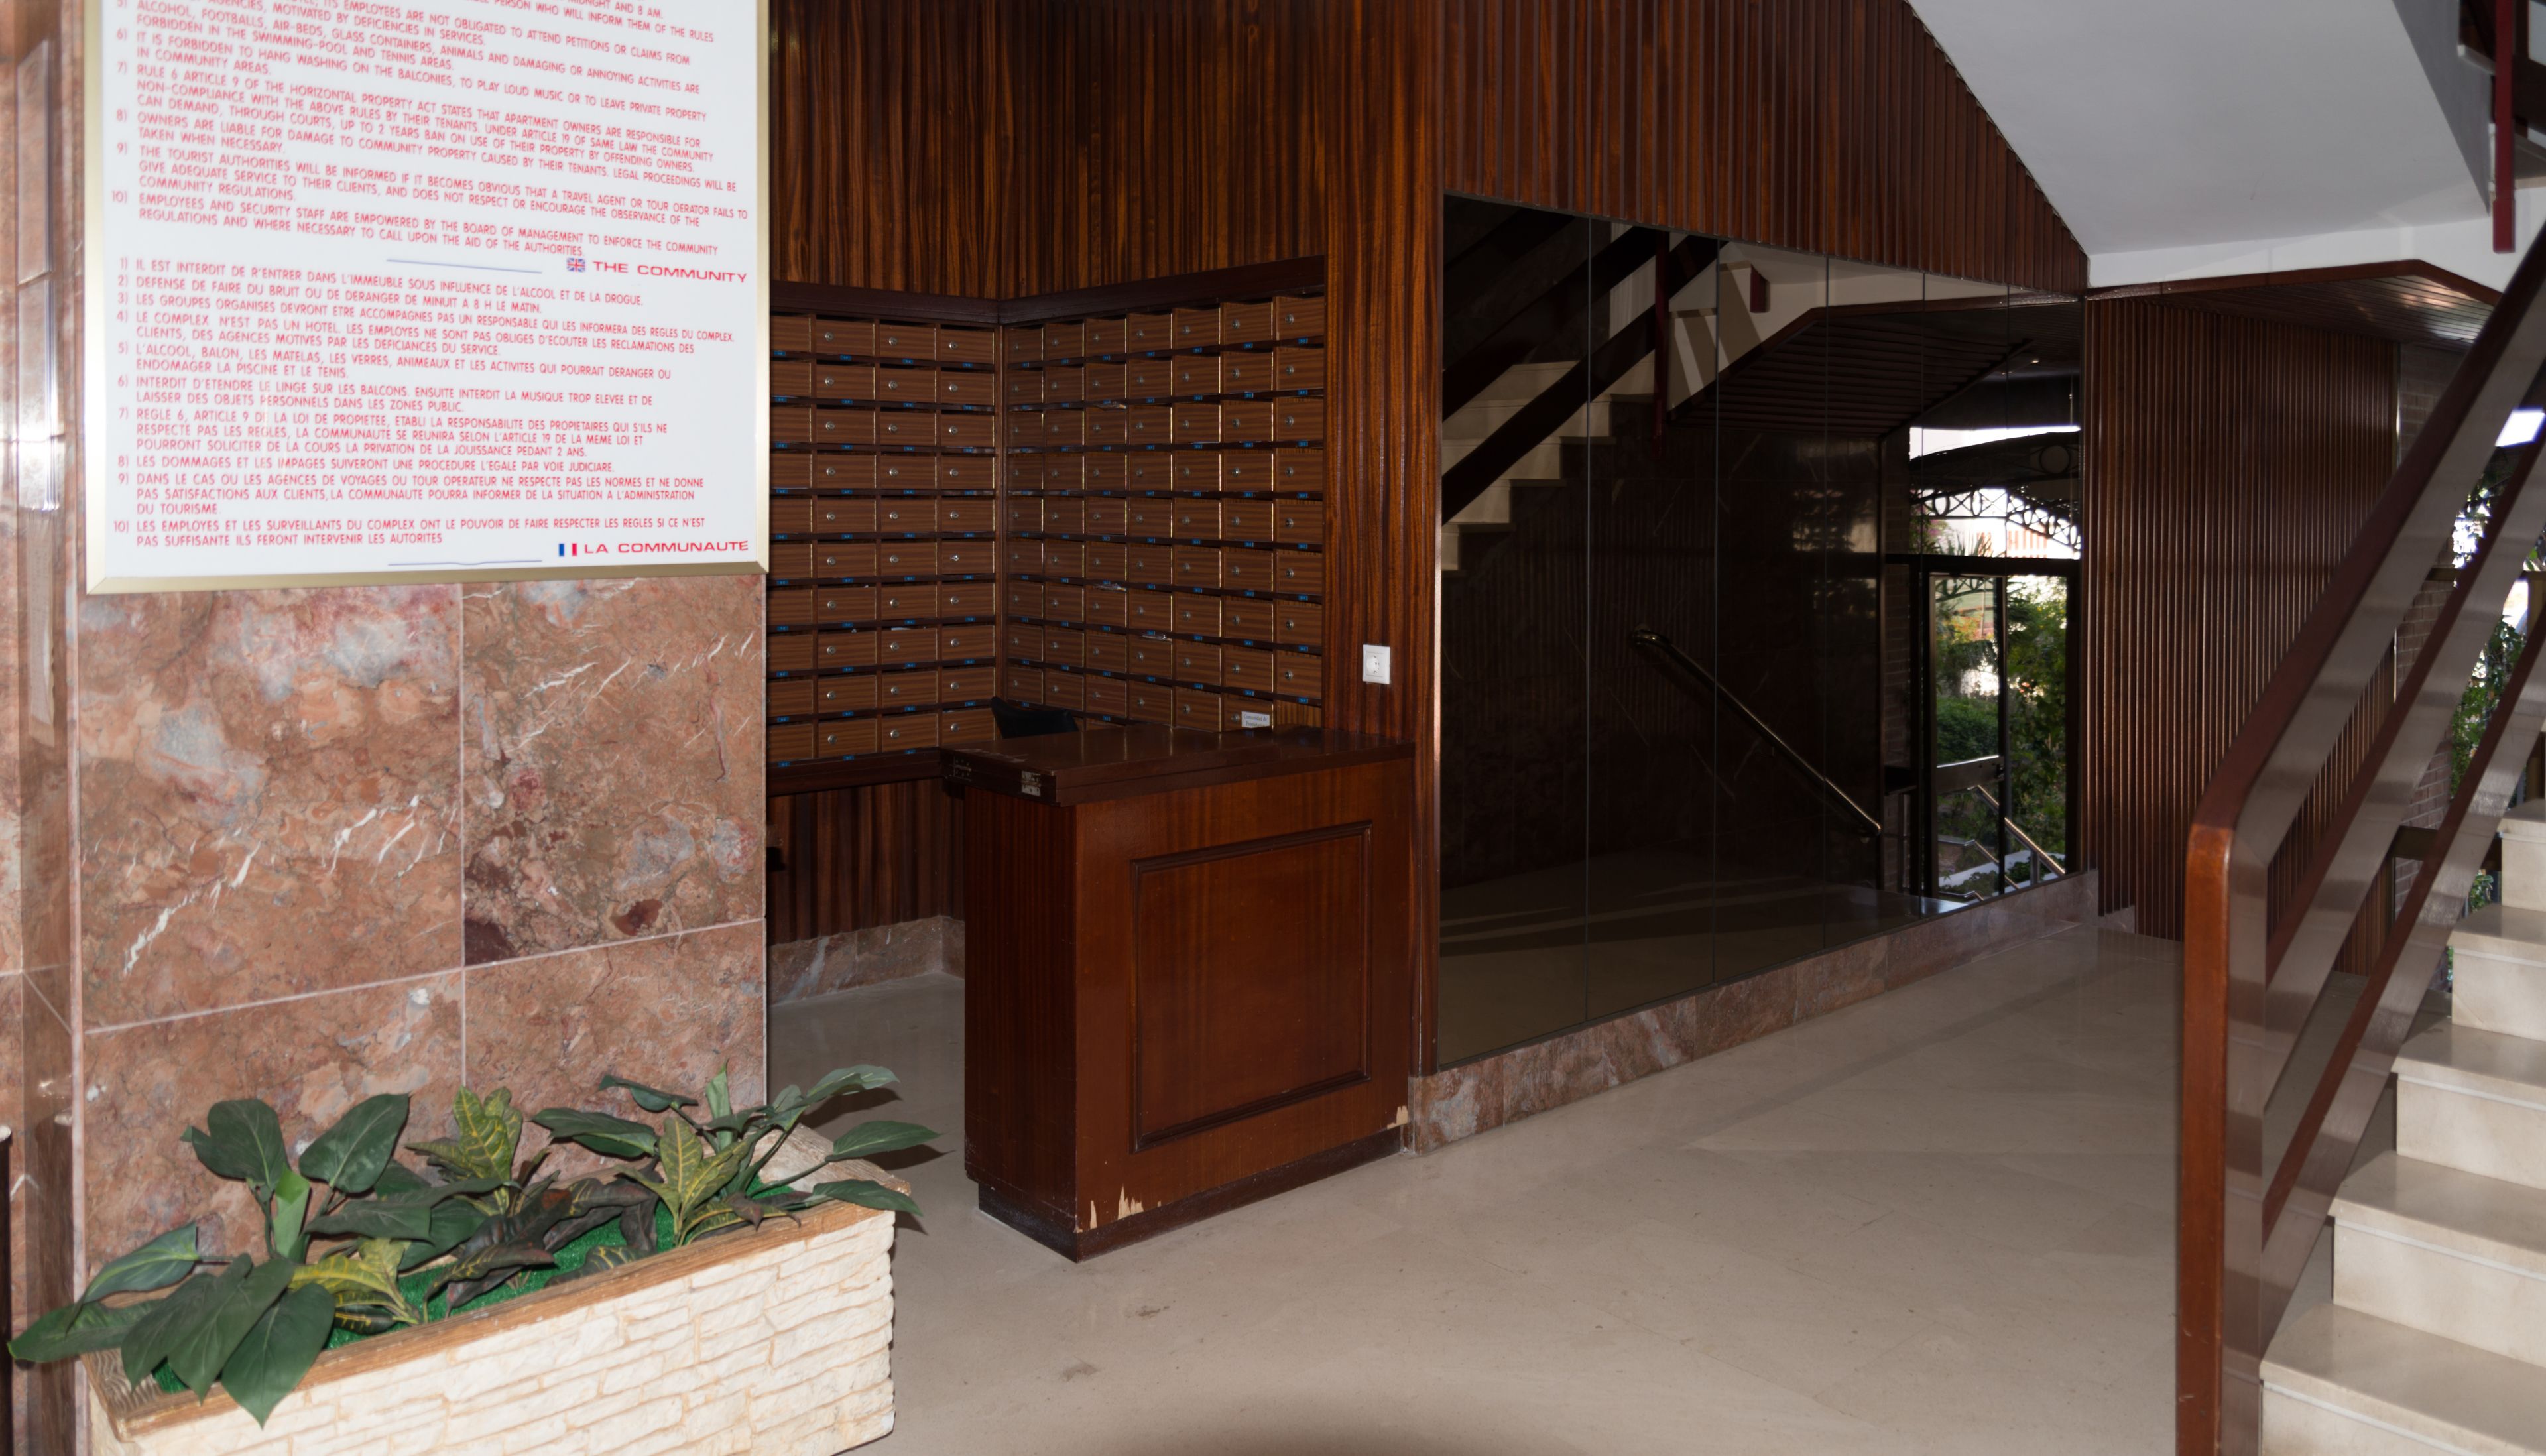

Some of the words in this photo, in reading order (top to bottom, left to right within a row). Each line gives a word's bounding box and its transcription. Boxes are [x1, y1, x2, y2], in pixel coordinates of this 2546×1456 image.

[137, 13, 202, 32] FORBIDDEN
[208, 24, 221, 34] IN
[226, 27, 247, 38] THE
[252, 30, 346, 53] SWIMMING-POOL
[352, 44, 376, 58] AND
[381, 49, 416, 64] TENNIS
[420, 55, 453, 69] AREAS.
[137, 46, 149, 56] IN
[155, 49, 228, 67] COMMUNITY
[233, 59, 271, 74] AREAS.
[137, 94, 162, 107] CAN
[169, 98, 223, 115] DEMAND,
[229, 105, 285, 122] THROUGH
[290, 112, 335, 129] COURTS,
[340, 118, 355, 131] UP
[360, 120, 374, 133] TO
[379, 123, 385, 134] 2
[389, 124, 420, 138] YEARS
[424, 129, 446, 141] BAN
[450, 132, 466, 144] ON
[469, 135, 488, 147] USE
[493, 137, 505, 149] OF
[509, 139, 536, 152] THEIR
[540, 143, 584, 158] PROPERTY
[588, 150, 599, 160] BY
[603, 151, 652, 166] OFFENDING
[657, 158, 696, 172] OWNERS.
[139, 126, 174, 141] TAKEN
[180, 131, 215, 145] WHEN
[220, 136, 285, 152] NECESSARY.
[138, 175, 213, 192] COMMUNITY
[218, 182, 296, 200] REGULATIONS.
[139, 160, 165, 174] GIVE
[171, 162, 227, 180] ADEQUATE
[234, 169, 277, 184] SERVICE
[282, 174, 298, 186] TO
[303, 176, 332, 189] THEIR
[337, 179, 381, 195] CLIENTS,
[385, 184, 408, 196] AND
[412, 188, 440, 201] DOES
[444, 191, 464, 202] NOT
[468, 193, 509, 206] RESPECT
[513, 198, 526, 208] OR
[530, 199, 586, 215] ENCOURAGE
[589, 206, 606, 216] THE
[610, 208, 666, 223] OBSERVANCE
[670, 213, 681, 224] OF
[684, 215, 699, 226] THE
[139, 208, 218, 224] REGULATIONS
[223, 215, 247, 226] AND
[253, 217, 291, 230] WHERE
[296, 221, 356, 236] NECESSARY
[361, 226, 375, 239] TO
[379, 229, 402, 240] CALL
[408, 231, 438, 243] UPON
[443, 233, 460, 245] THE
[464, 235, 482, 246] AID
[485, 237, 499, 249] OF
[503, 239, 520, 249] THE
[524, 241, 585, 256] AUTHORITIES.
[135, 259, 146, 269] IL
[151, 259, 170, 271] EST
[176, 261, 225, 274] INTERDIT
[231, 265, 245, 276] DE
[251, 266, 302, 280] R'ENTRER
[307, 271, 337, 283] DANS
[342, 273, 402, 287] L'IMMEUBLE
[408, 278, 436, 290] SOUS
[440, 280, 491, 294] INFLUENCE
[495, 284, 508, 295] DE
[511, 286, 555, 298] L'ALCOOL
[559, 289, 570, 300] ET
[574, 290, 585, 300] DE
[589, 292, 601, 302] LA
[604, 293, 644, 305] DROGUE.
[593, 261, 627, 273] THE
[636, 265, 747, 282] COMMUNITY
[135, 276, 185, 289] DEFENSE
[191, 279, 206, 290] DE
[212, 281, 241, 292] FAIRE
[246, 282, 263, 294] DU
[269, 284, 300, 296] BRUIT
[305, 286, 322, 298] OU
[326, 288, 340, 300] DE
[345, 290, 400, 303] DERANGER
[404, 294, 418, 304] DE
[422, 295, 457, 306] MINUIT
[462, 298, 469, 308] A
[473, 299, 480, 309] 8
[484, 300, 493, 308] H
[496, 300, 506, 311] LE
[511, 301, 543, 312] MATIN.
[135, 292, 154, 304] LES
[159, 294, 211, 308] GROUPES
[215, 298, 276, 312] ORGANISES
[280, 302, 328, 315] DEVRONT
[332, 305, 355, 316] ETRE
[359, 307, 434, 321] ACCOMPAGNES
[436, 312, 455, 323] PAS
[459, 314, 473, 324] UN
[477, 314, 538, 328] RESPONSABLE
[542, 319, 559, 330] QUI
[562, 320, 576, 331] LES
[579, 322, 628, 334] INFORMERA
[631, 325, 646, 335] DES
[649, 326, 678, 337] REGLES
[680, 329, 694, 339] DU
[696, 330, 735, 341] COMPLEX.
[136, 359, 212, 371] ENDOMAGER
[217, 363, 231, 371] LA
[236, 362, 278, 374] PISCINE
[283, 364, 296, 375] ET
[300, 365, 312, 375] LE
[318, 365, 349, 377] TENIS.
[136, 391, 181, 402] LAISSER
[187, 392, 209, 403] DES
[213, 393, 255, 405] OBJETS
[259, 394, 330, 406] PERSONNELS
[333, 397, 363, 408] DANS
[367, 398, 385, 409] LES
[389, 398, 424, 410] ZONES
[427, 400, 465, 412] PUBLIC.
[136, 455, 156, 467] LES
[161, 455, 231, 467] DOMMAGES
[236, 456, 249, 467] ET
[254, 457, 273, 468] LES
[330, 458, 388, 469] SUIVERONT
[393, 459, 413, 469] UNE
[418, 459, 476, 469] PROCEDURE
[481, 460, 516, 470] L'EGALE
[521, 461, 539, 470] PAR
[544, 461, 564, 471] VOIE
[569, 461, 615, 472] JUDICIARE.
[137, 536, 159, 545] PAS
[164, 534, 230, 545] SUFFISANTE
[235, 535, 252, 544] ILS
[256, 534, 298, 543] FERONT
[304, 533, 363, 543] INTERVENIR
[368, 533, 385, 543] LES
[389, 532, 444, 542] AUTORITES
[583, 543, 609, 554] LA
[617, 540, 748, 552] COMMUNAUTE
